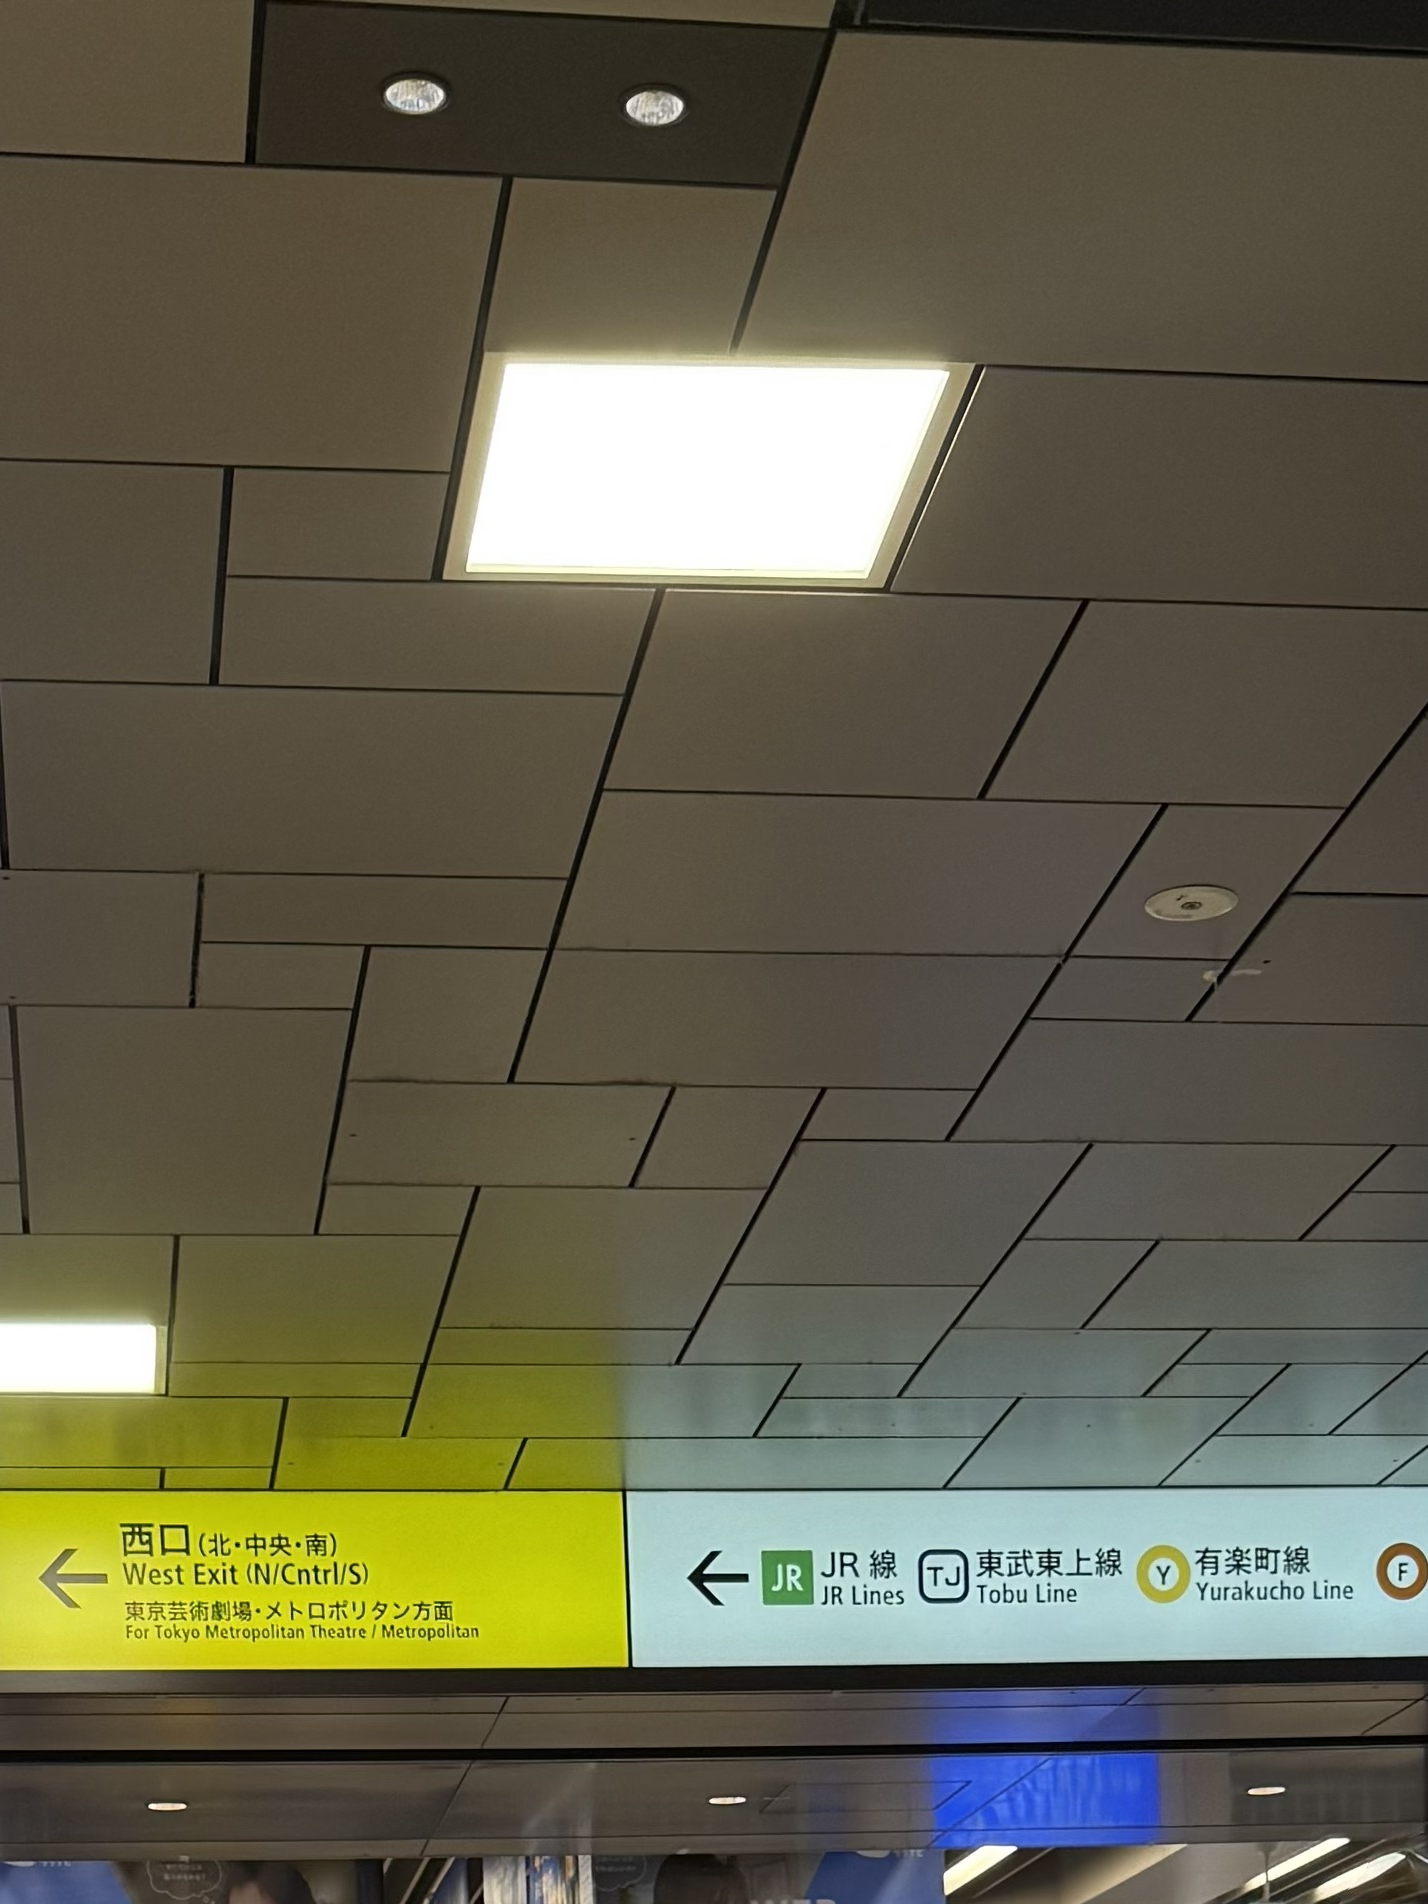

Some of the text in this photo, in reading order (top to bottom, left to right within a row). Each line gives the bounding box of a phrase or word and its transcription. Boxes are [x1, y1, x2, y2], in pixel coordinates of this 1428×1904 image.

[975, 1548, 1124, 1579] 東武東上線
[1194, 1545, 1310, 1576] 有楽町線
[1396, 1560, 1410, 1582] F
[123, 1562, 369, 1587] West Exit (N/Cntrl/S)
[772, 1562, 802, 1592] JR
[926, 1563, 962, 1588] TJ
[1155, 1562, 1172, 1586] Y
[821, 1584, 905, 1606] JR Lines
[975, 1581, 1078, 1604] Tobu Line
[1194, 1578, 1354, 1604] Yurakucho Line
[125, 1600, 454, 1622] 東京芸術劇場・メトロポリタン方面
[126, 1624, 150, 1639] For
[154, 1624, 201, 1642] Tokyo
[205, 1623, 304, 1642] Metropolitan
[309, 1623, 367, 1639] Theatre
[382, 1622, 480, 1641] Metropolitan
